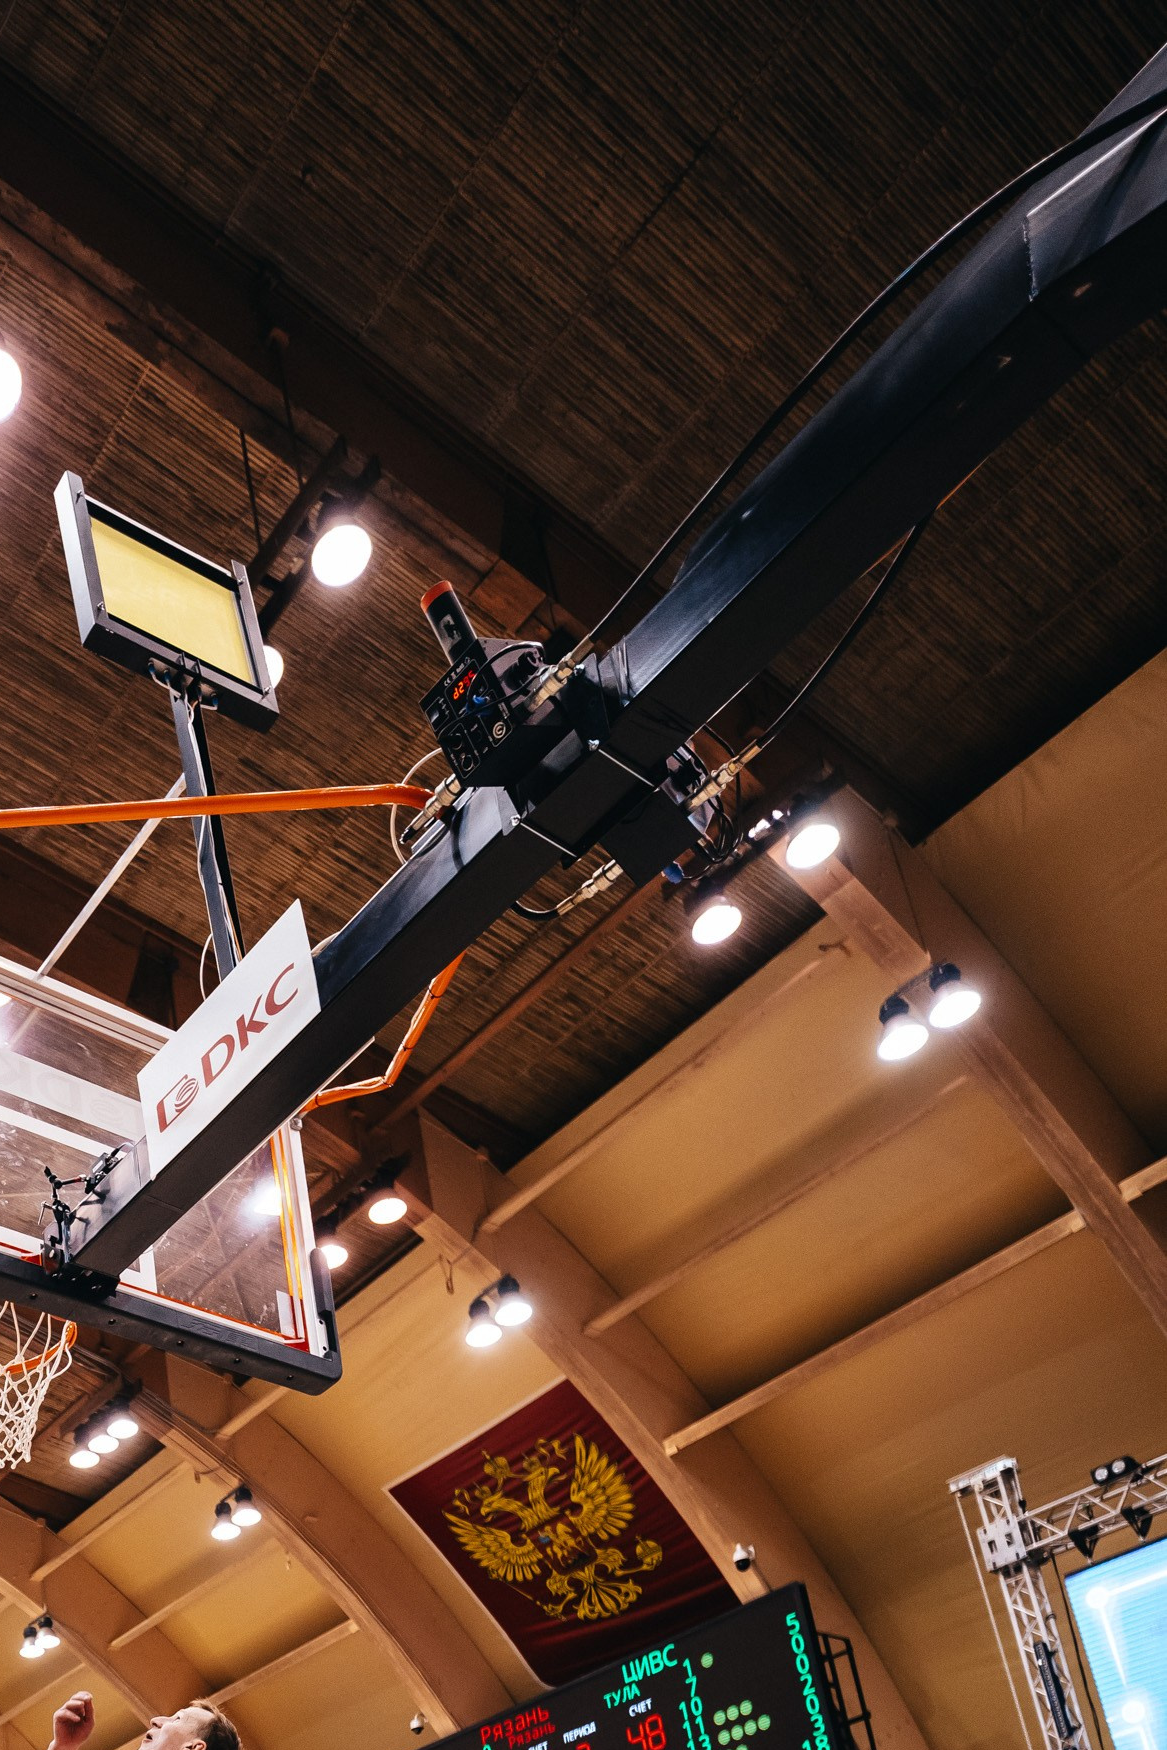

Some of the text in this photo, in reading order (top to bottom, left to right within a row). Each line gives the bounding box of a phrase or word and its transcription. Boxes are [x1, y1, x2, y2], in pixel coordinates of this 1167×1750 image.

[200, 962, 299, 1088] DKC
[622, 1643, 677, 1684] ЦИВС
[683, 1612, 800, 1678] 1 5
[685, 1633, 805, 1697] 7 0
[604, 1683, 640, 1709] ТУЛА
[629, 1697, 652, 1718] СЧЕТ
[678, 1653, 810, 1721] 10 0
[683, 1674, 816, 1741] 11 2
[805, 1693, 820, 1715] 0
[563, 1720, 596, 1744] ПЕРИОД
[810, 1714, 825, 1737] 3
